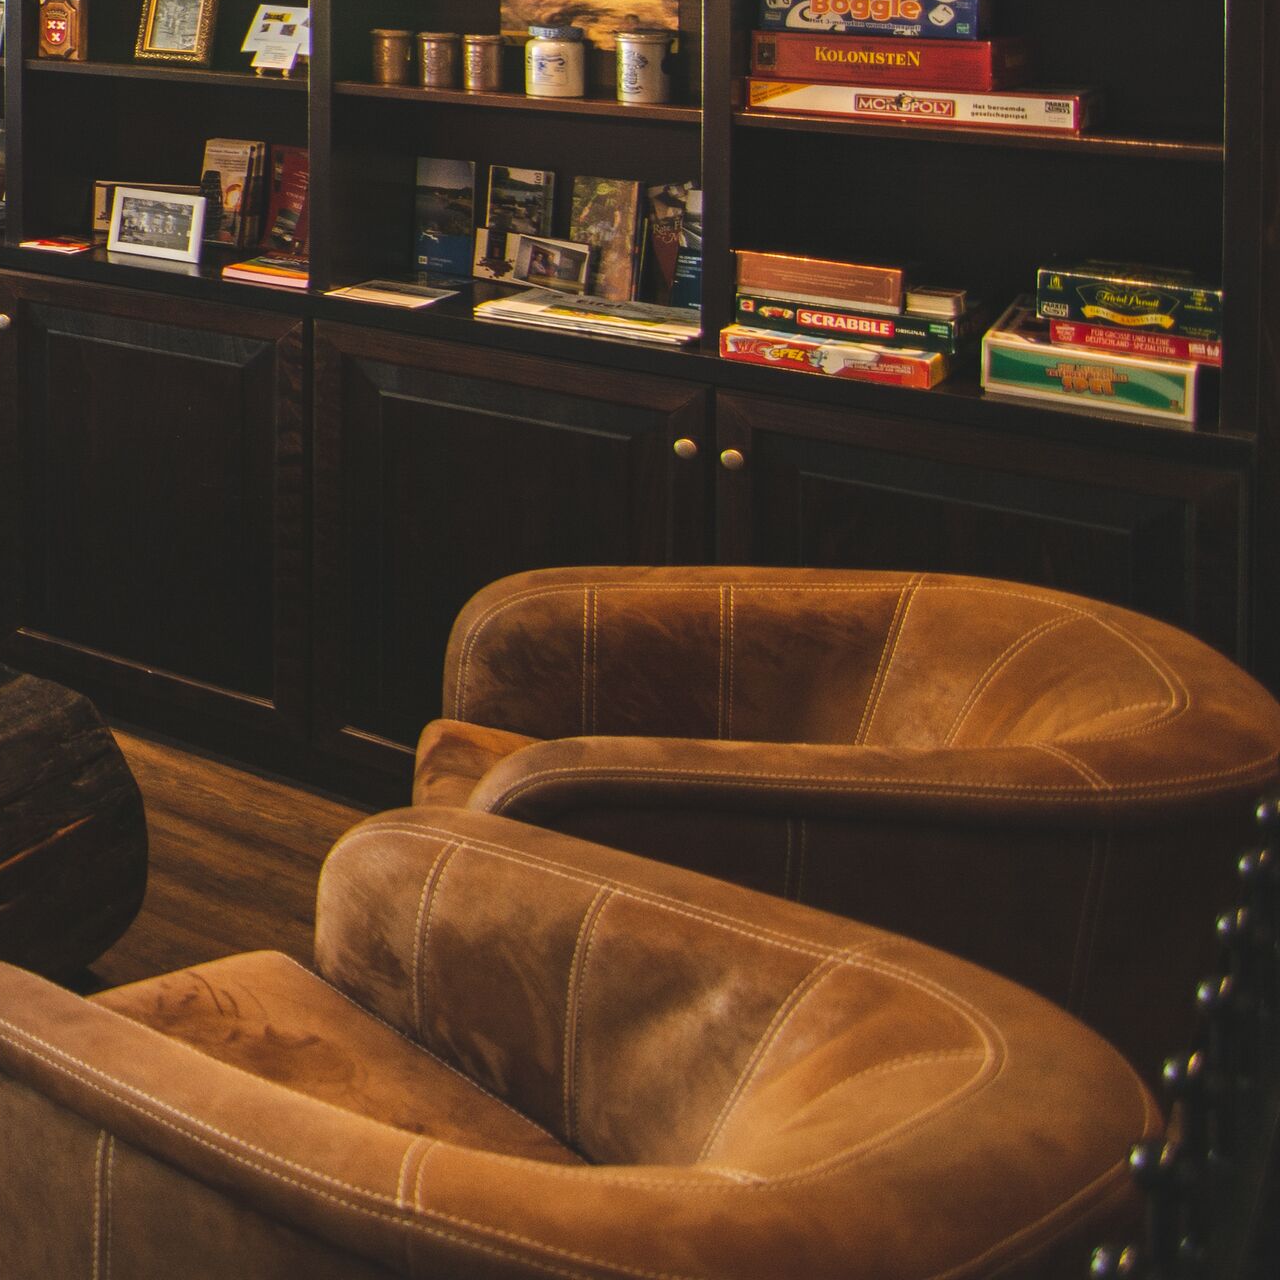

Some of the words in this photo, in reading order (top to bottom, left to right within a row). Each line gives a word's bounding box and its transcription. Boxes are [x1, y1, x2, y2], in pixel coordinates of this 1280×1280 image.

[815, 46, 921, 67] KOLONISTEN
[857, 98, 951, 115] MONOPOLY
[987, 104, 1026, 112] beroemde
[1100, 291, 1129, 306] Trivial
[1128, 293, 1161, 309] Pursuit
[800, 312, 890, 335] SCRABBLE
[895, 327, 927, 337] ORIGINAL
[1090, 328, 1103, 337] FÜR
[1104, 330, 1130, 340] GROSSE
[1131, 333, 1146, 342] UND
[1147, 335, 1170, 345] KLEINE
[771, 347, 805, 362] SPEL
